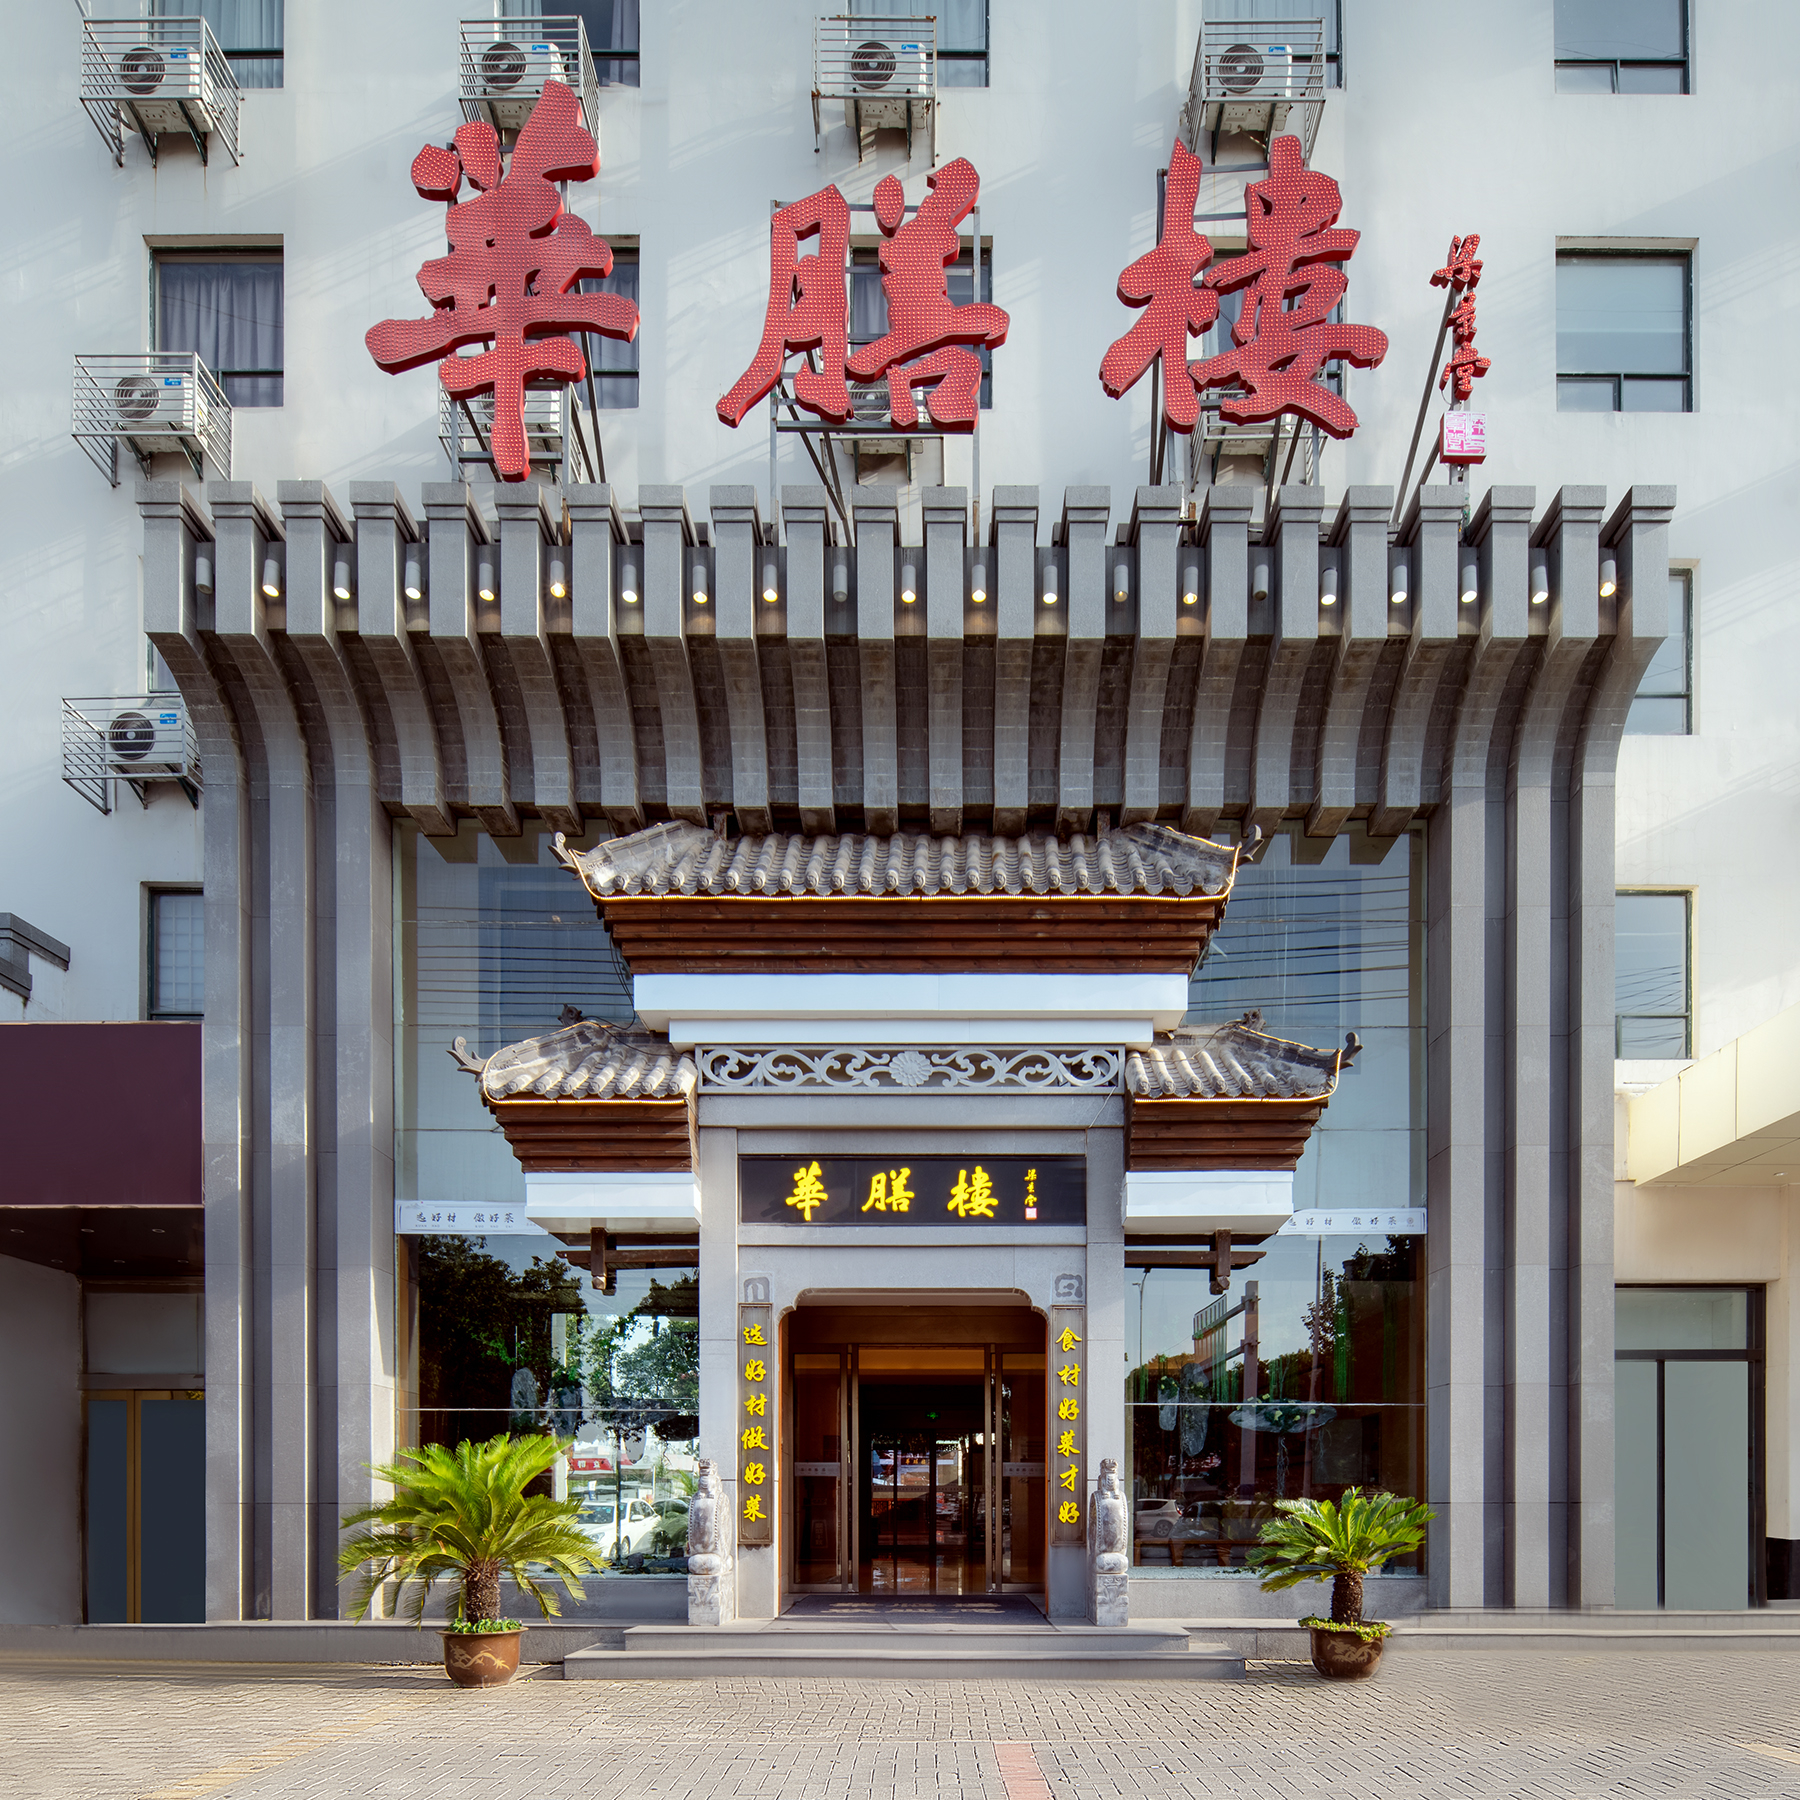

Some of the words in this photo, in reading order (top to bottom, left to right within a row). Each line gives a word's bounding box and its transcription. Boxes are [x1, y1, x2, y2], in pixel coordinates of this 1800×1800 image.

[365, 80, 1389, 482] 華膳樓
[785, 1160, 999, 1222] 華膳樓
[741, 1323, 769, 1522] 选好材做好菜
[1055, 1326, 1082, 1524] 食材好菜才好
